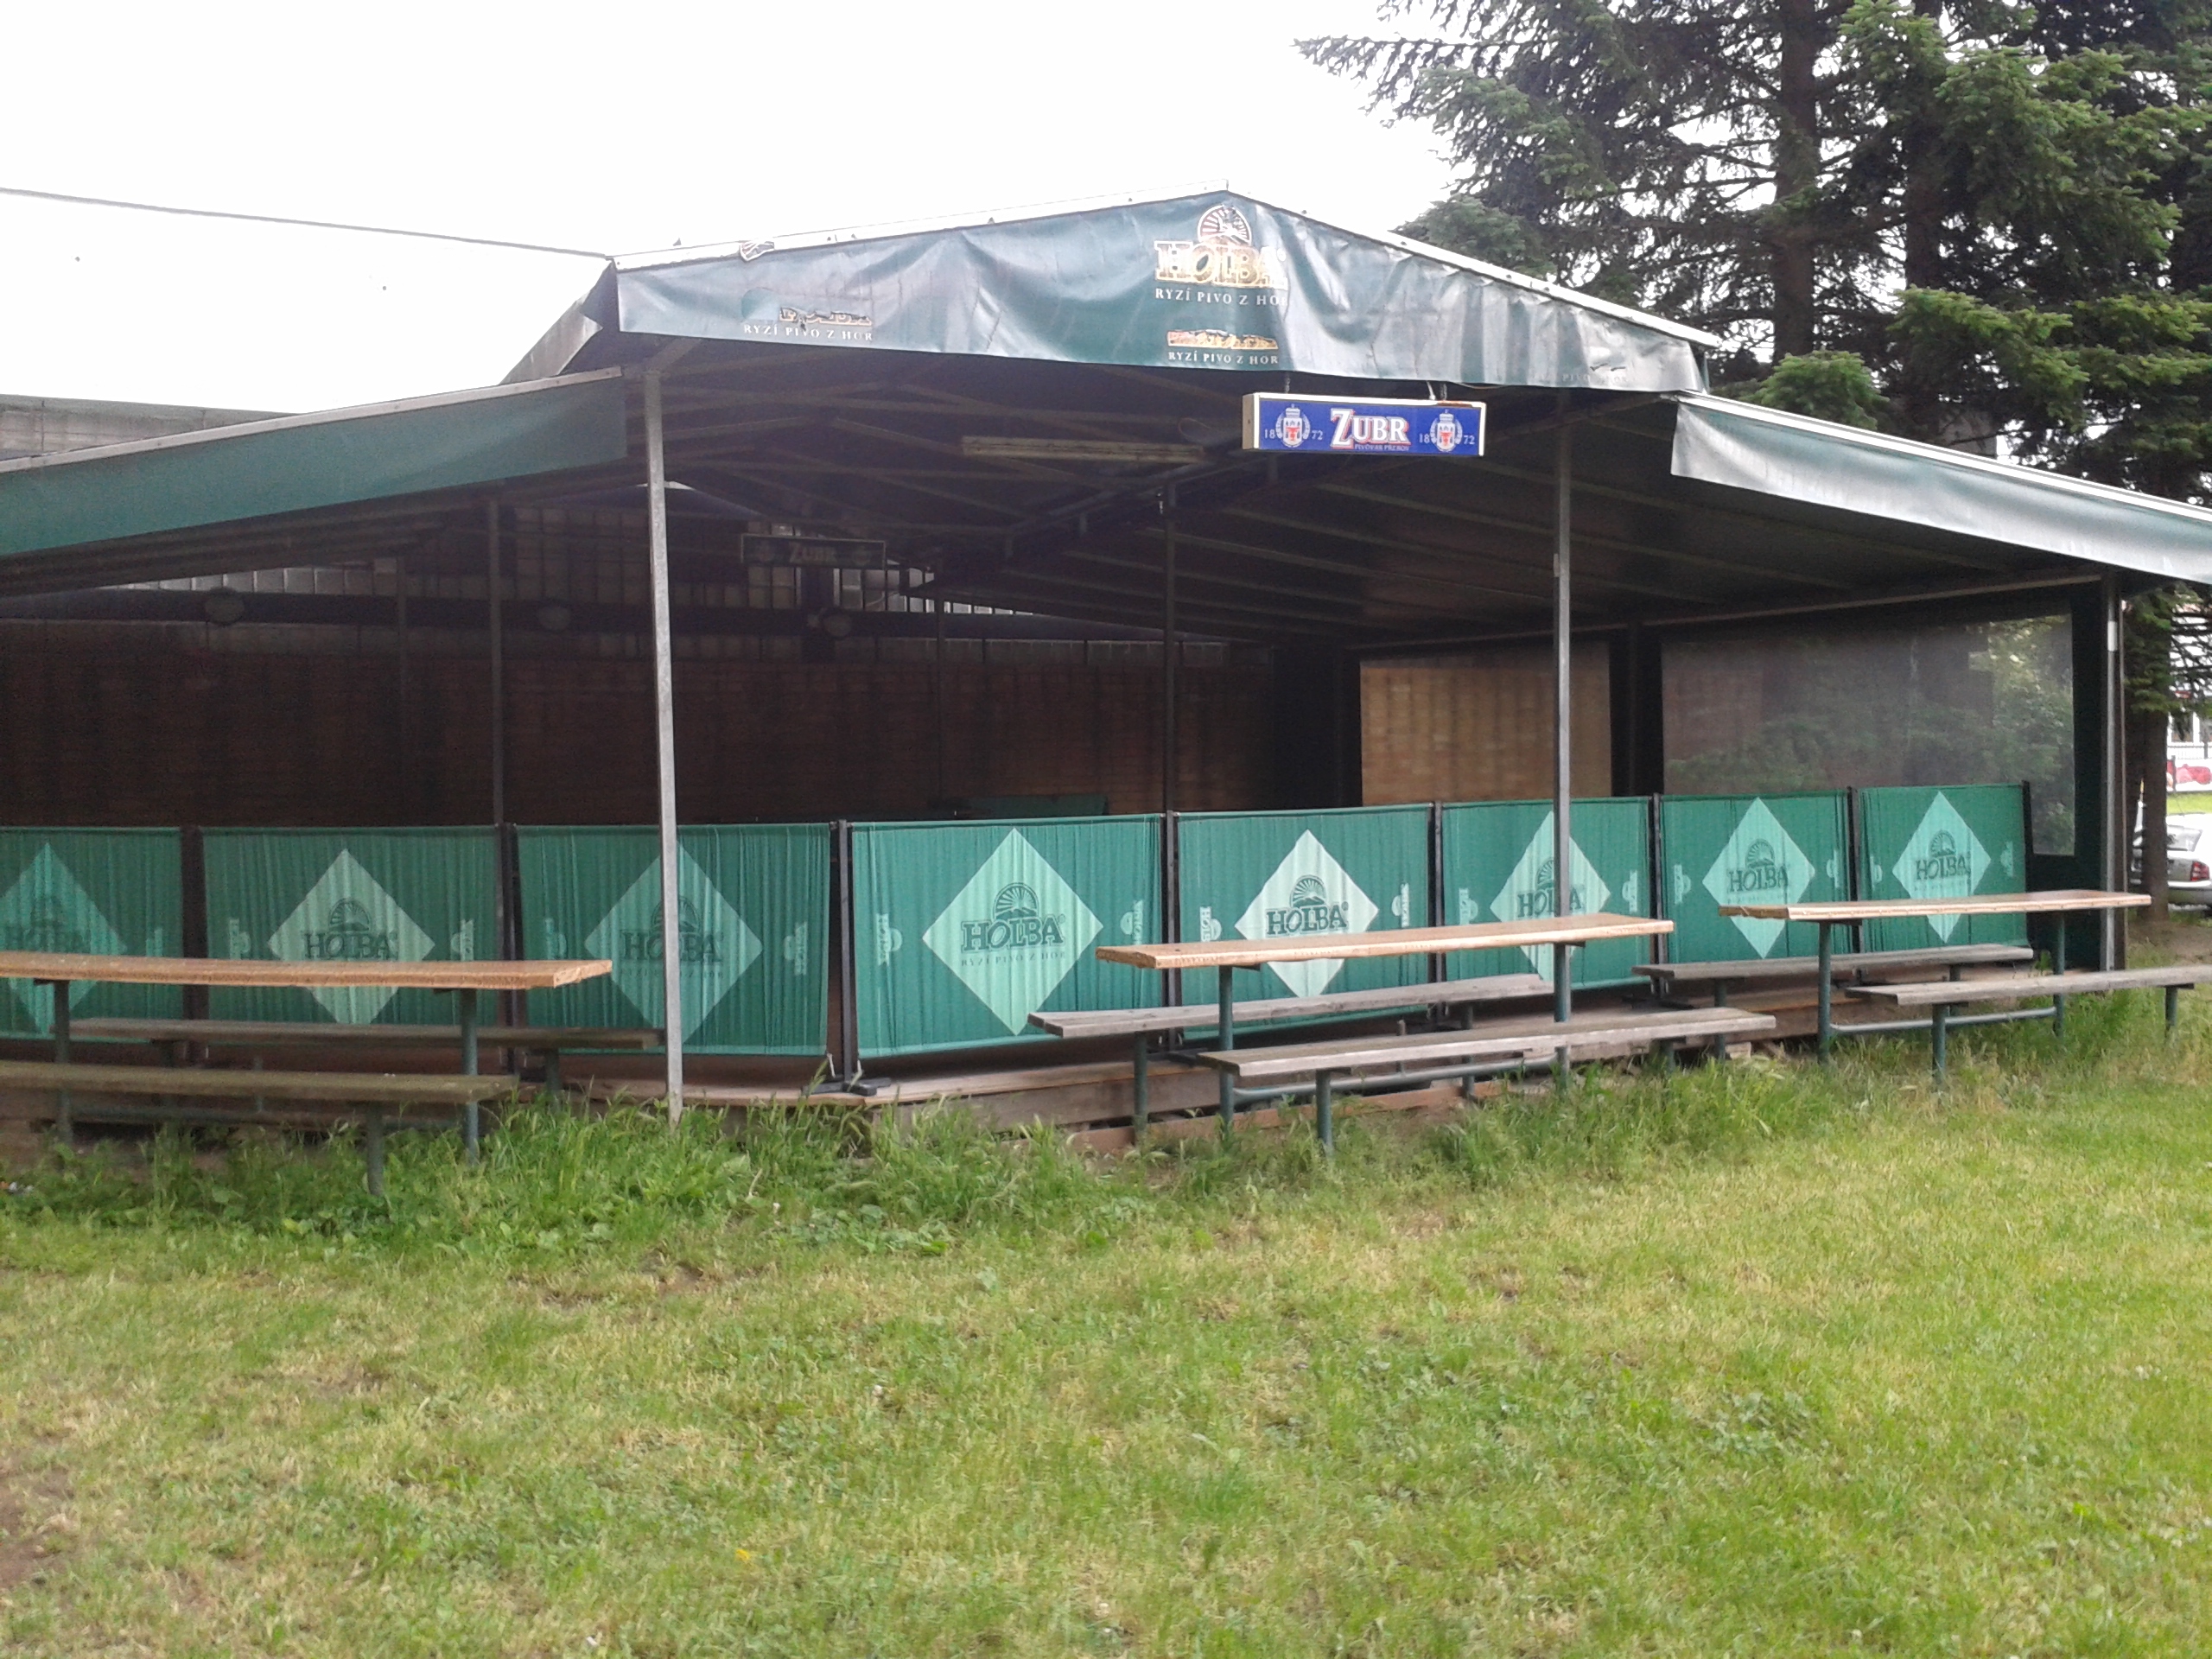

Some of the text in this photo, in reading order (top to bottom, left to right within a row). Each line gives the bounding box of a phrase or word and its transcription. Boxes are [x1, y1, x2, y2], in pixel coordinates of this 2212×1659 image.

[1155, 288, 1191, 301] RYZÍ
[1198, 291, 1233, 304] PIVO
[1239, 295, 1249, 305] Z
[744, 325, 873, 341] RYZÍ PIVO Z HOR
[1168, 350, 1279, 365] RYZÍ PIVO Z HOR
[1264, 408, 1475, 448] 18 72 ZUBR 18 72
[1727, 865, 1789, 893] HOLBA
[1915, 855, 1971, 880] HOLBA
[1517, 887, 1582, 918] HOLA
[961, 914, 1065, 953] HOLBA
[1266, 906, 1349, 937] HOLBA
[304, 931, 400, 961] HOLBA
[621, 931, 721, 962] HOBA
